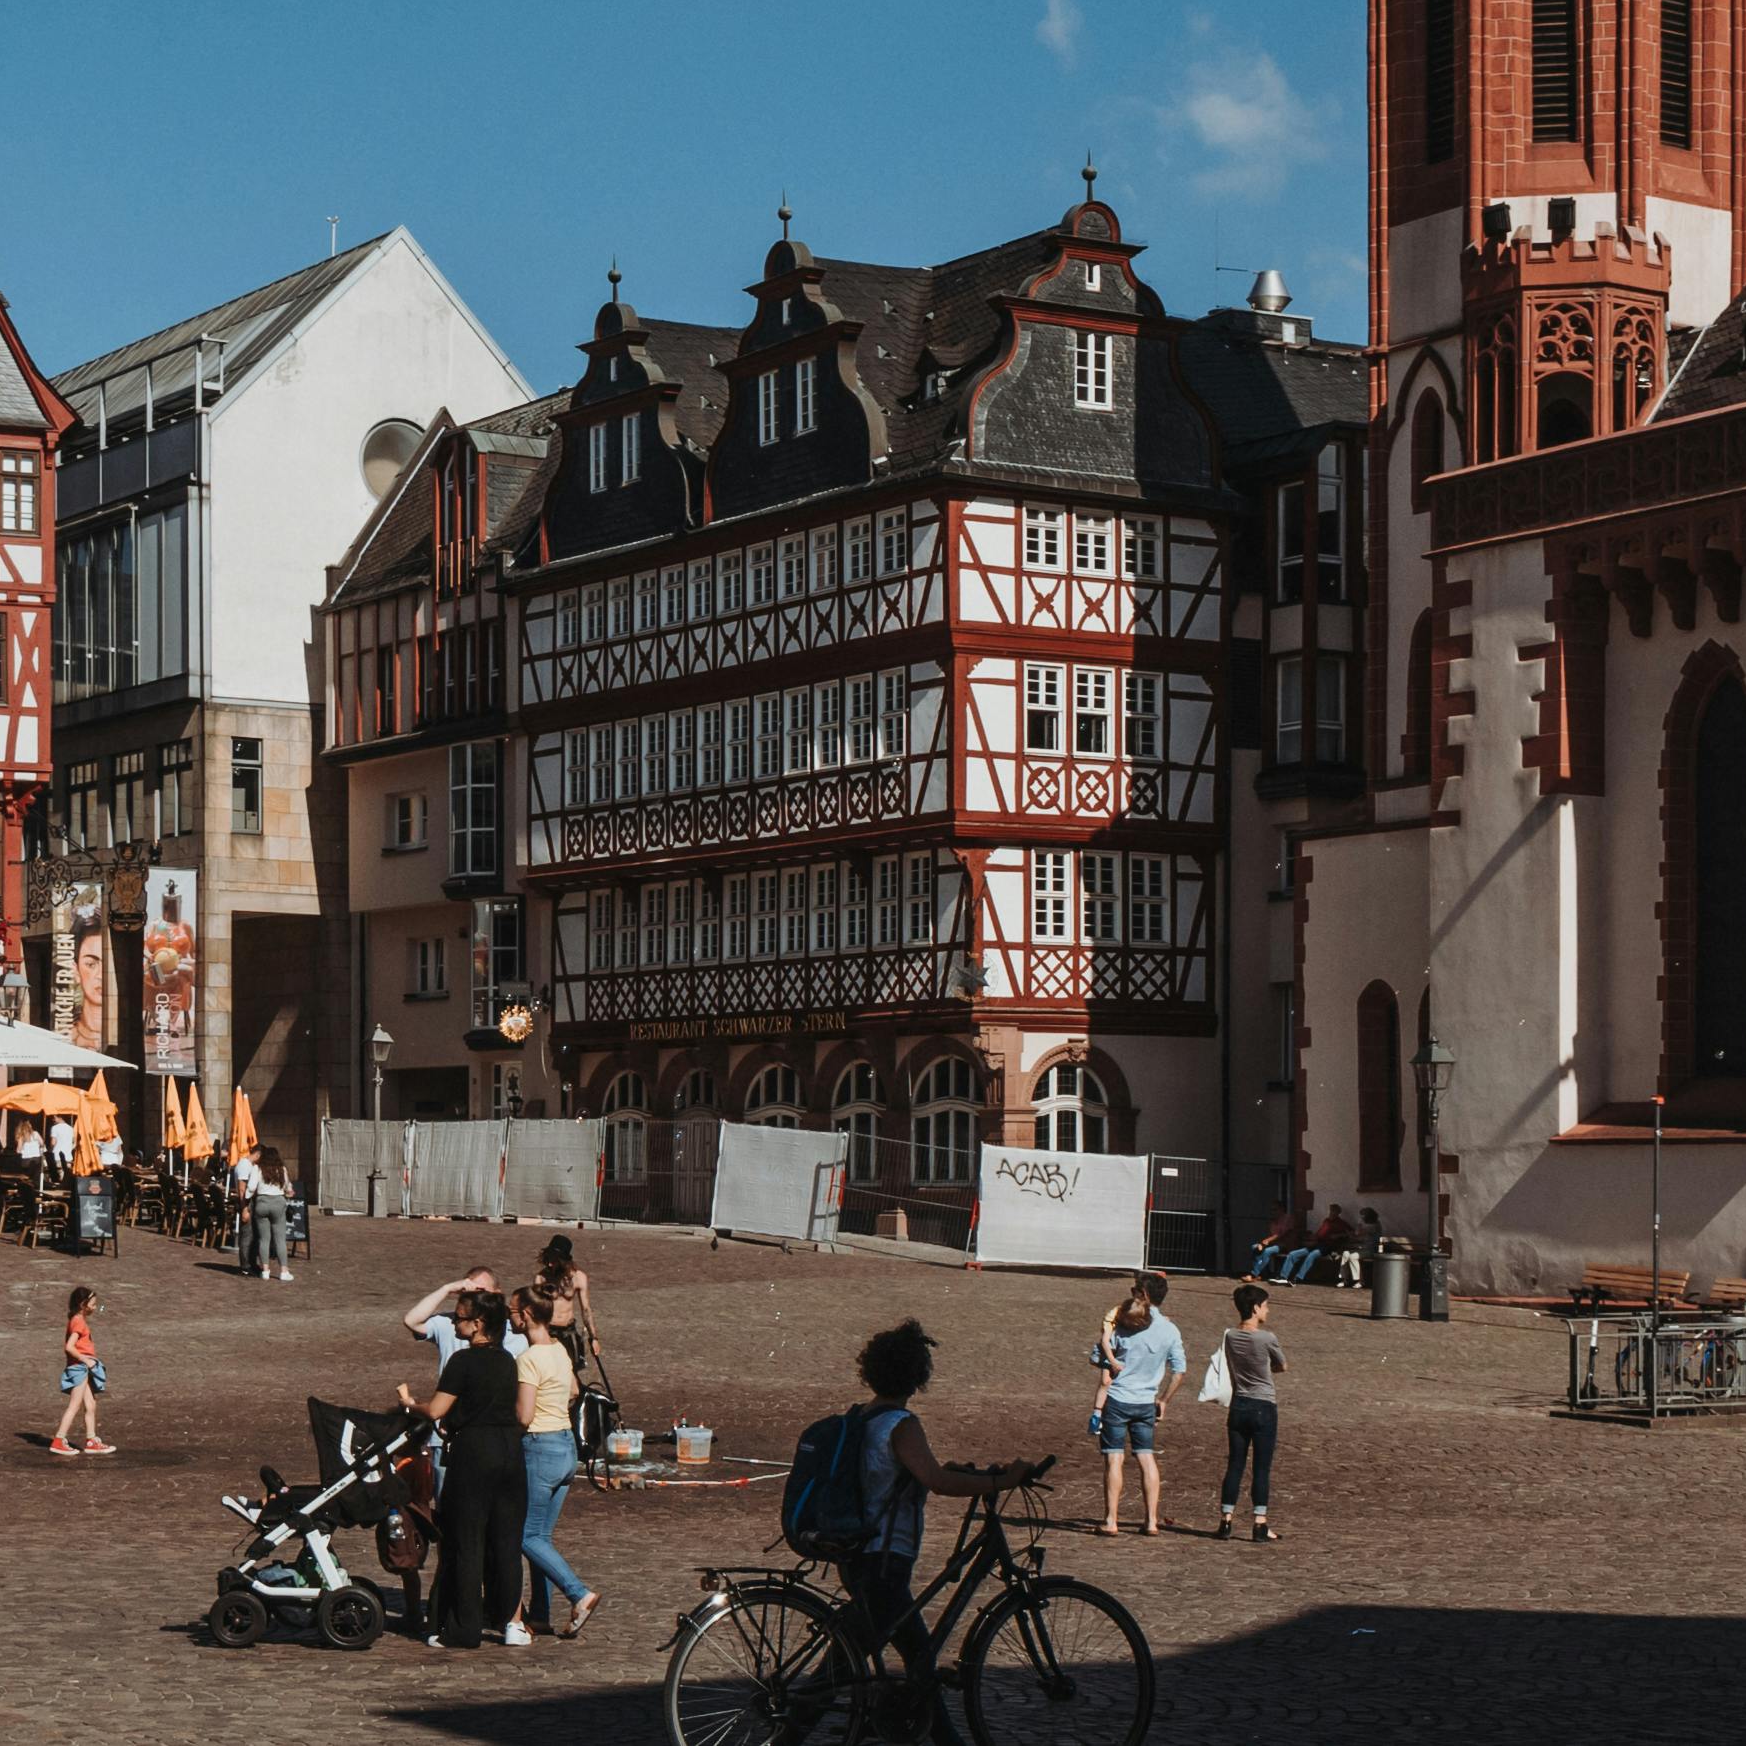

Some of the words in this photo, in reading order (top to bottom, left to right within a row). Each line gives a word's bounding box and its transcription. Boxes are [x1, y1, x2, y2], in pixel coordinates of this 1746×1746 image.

[57, 933, 75, 984] FRAUEN
[156, 993, 170, 1059] RICHARD
[630, 1020, 707, 1041] RESTAURANT
[713, 1015, 792, 1037] SCHWARZER
[995, 1158, 1081, 1203] ACAB!
